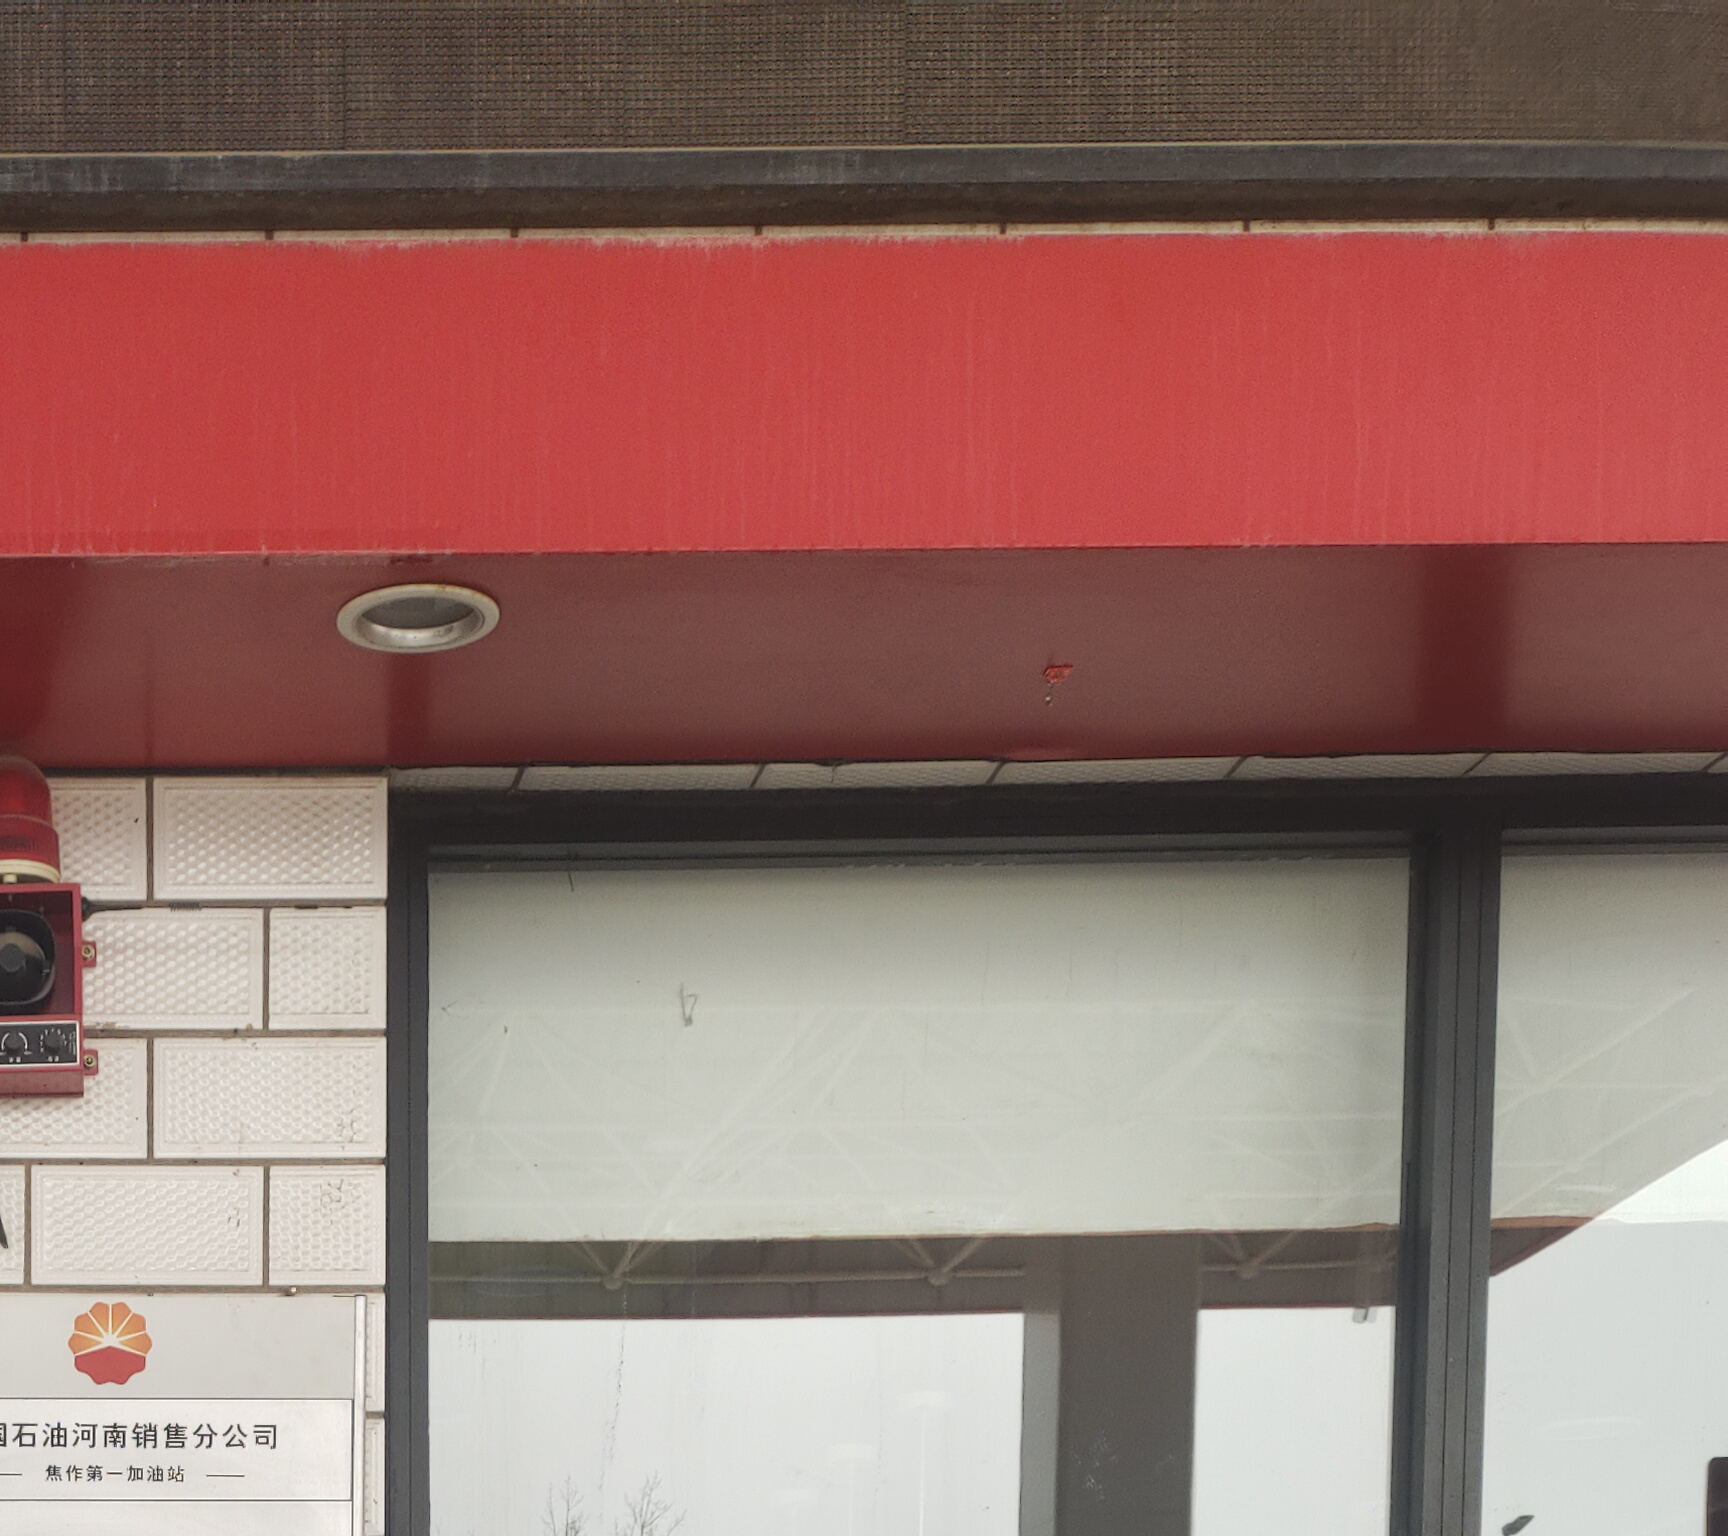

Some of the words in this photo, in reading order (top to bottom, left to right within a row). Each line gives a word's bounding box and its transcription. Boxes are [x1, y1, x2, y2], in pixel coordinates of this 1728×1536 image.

[45, 1464, 185, 1483] 焦作第一加油站
